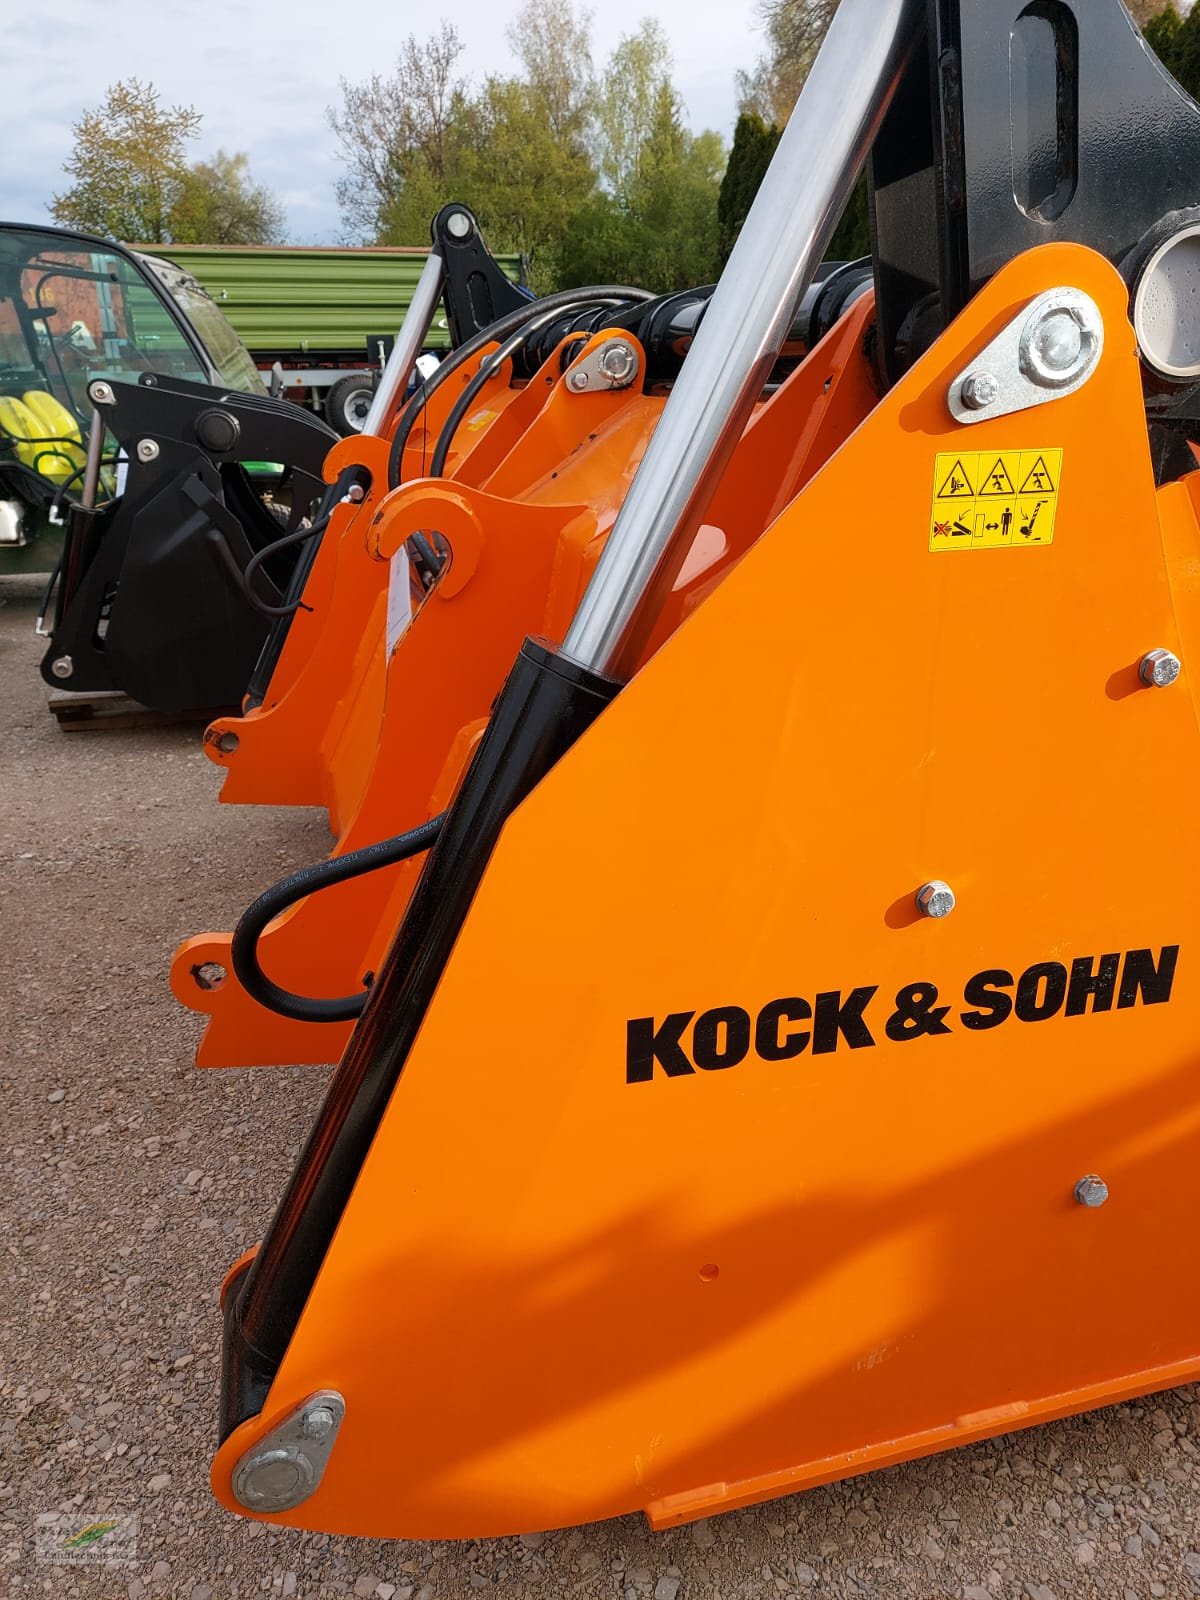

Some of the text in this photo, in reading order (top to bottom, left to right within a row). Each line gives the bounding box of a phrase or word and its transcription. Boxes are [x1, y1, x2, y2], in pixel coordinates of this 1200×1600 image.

[626, 945, 1179, 1084] KOCK & SOHN
